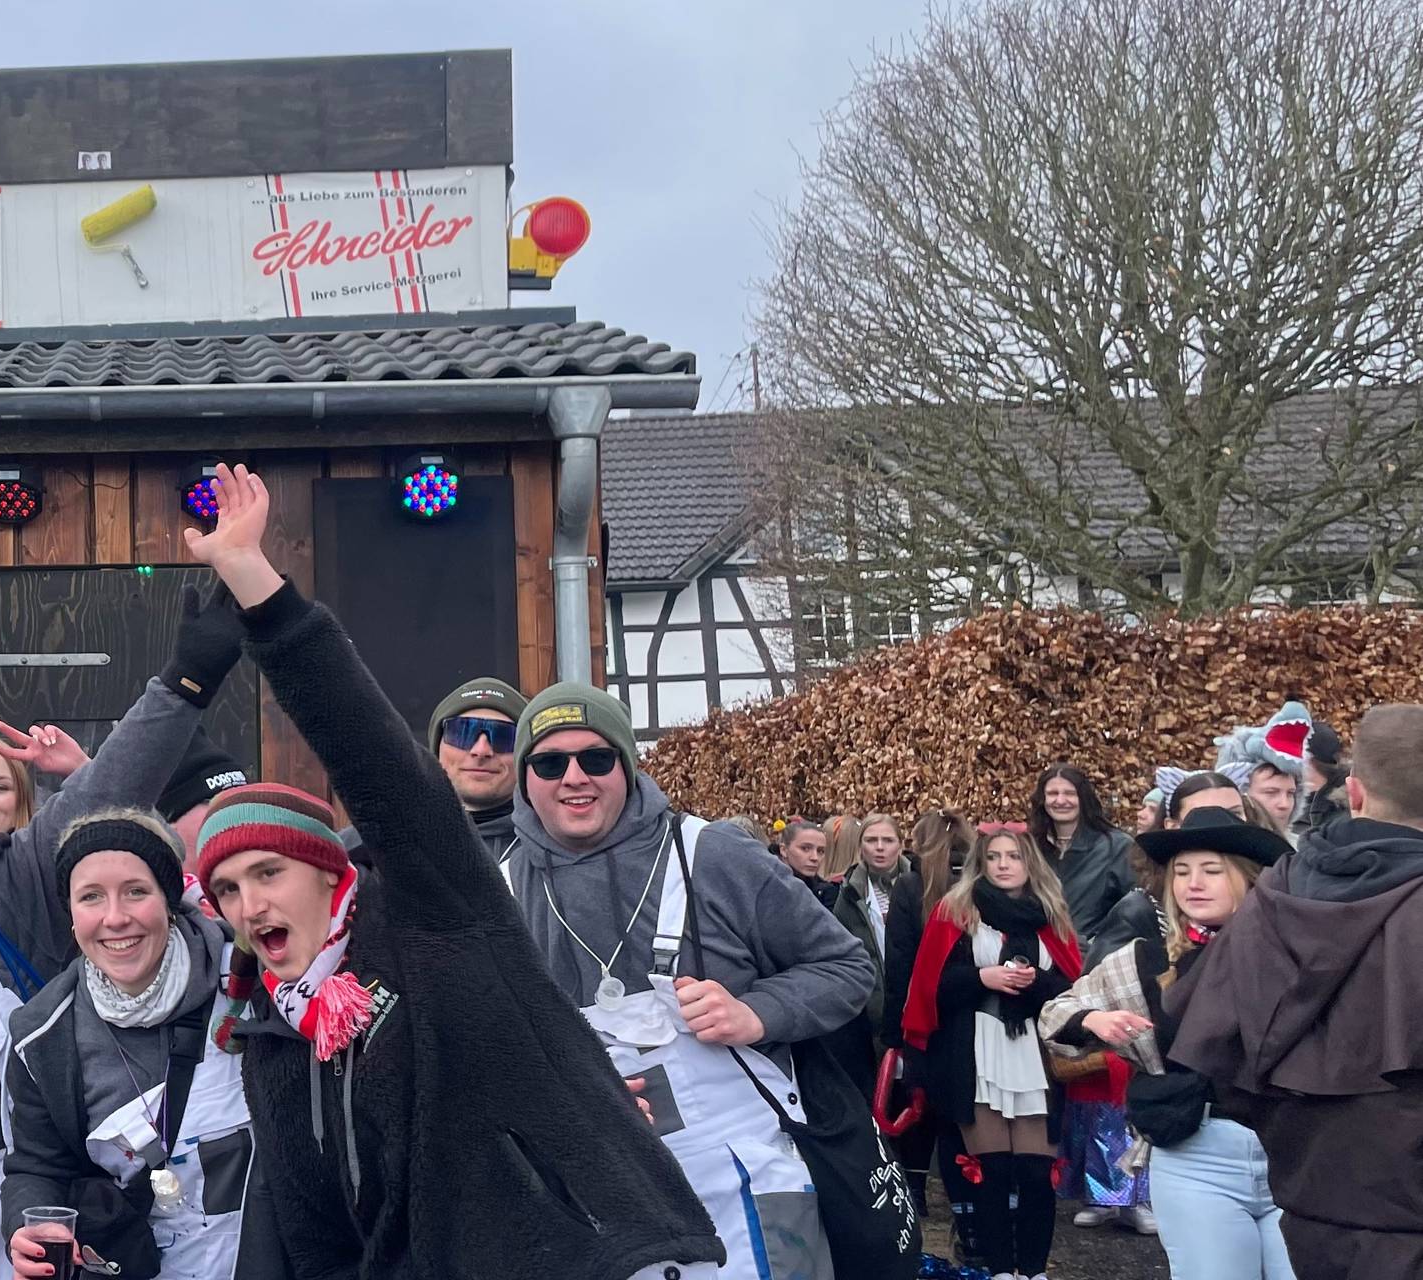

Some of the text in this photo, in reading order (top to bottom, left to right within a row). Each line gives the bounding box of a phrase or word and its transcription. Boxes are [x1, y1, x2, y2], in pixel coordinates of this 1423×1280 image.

[269, 194, 295, 203] aus
[300, 191, 339, 201] Liebe
[344, 190, 374, 199] zum
[379, 186, 467, 198] Besonderen
[252, 203, 473, 275] Schneider
[311, 290, 337, 301] Ihre
